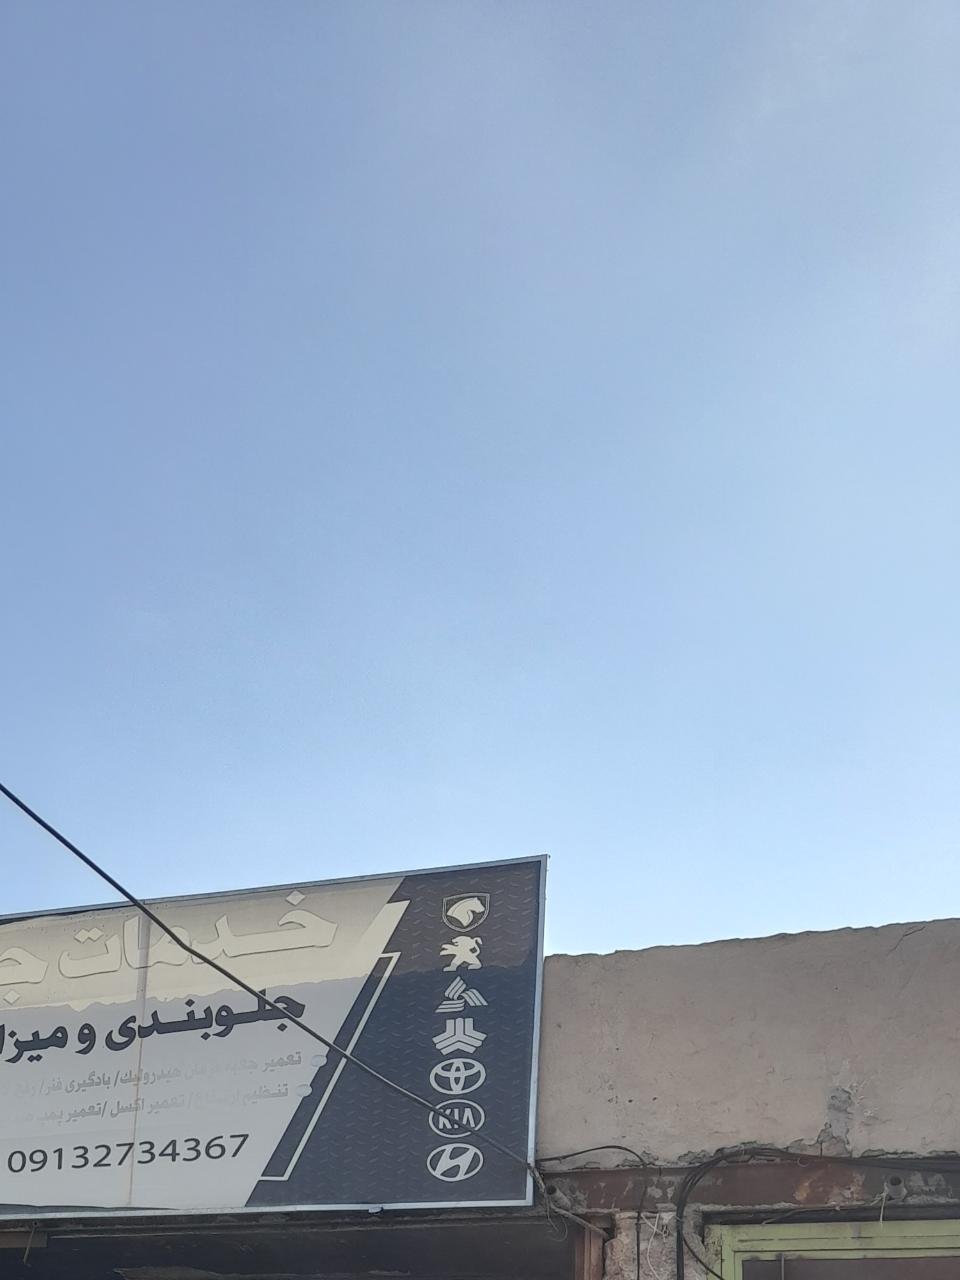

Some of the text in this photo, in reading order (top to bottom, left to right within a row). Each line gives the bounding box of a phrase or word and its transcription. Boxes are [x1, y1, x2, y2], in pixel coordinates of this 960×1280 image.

[58, 889, 338, 979] خدمات
[77, 1023, 97, 1054] و
[105, 988, 306, 1053] جلوبندی
[262, 1050, 302, 1073] تعمیر
[6, 1133, 251, 1174] 09132734367
